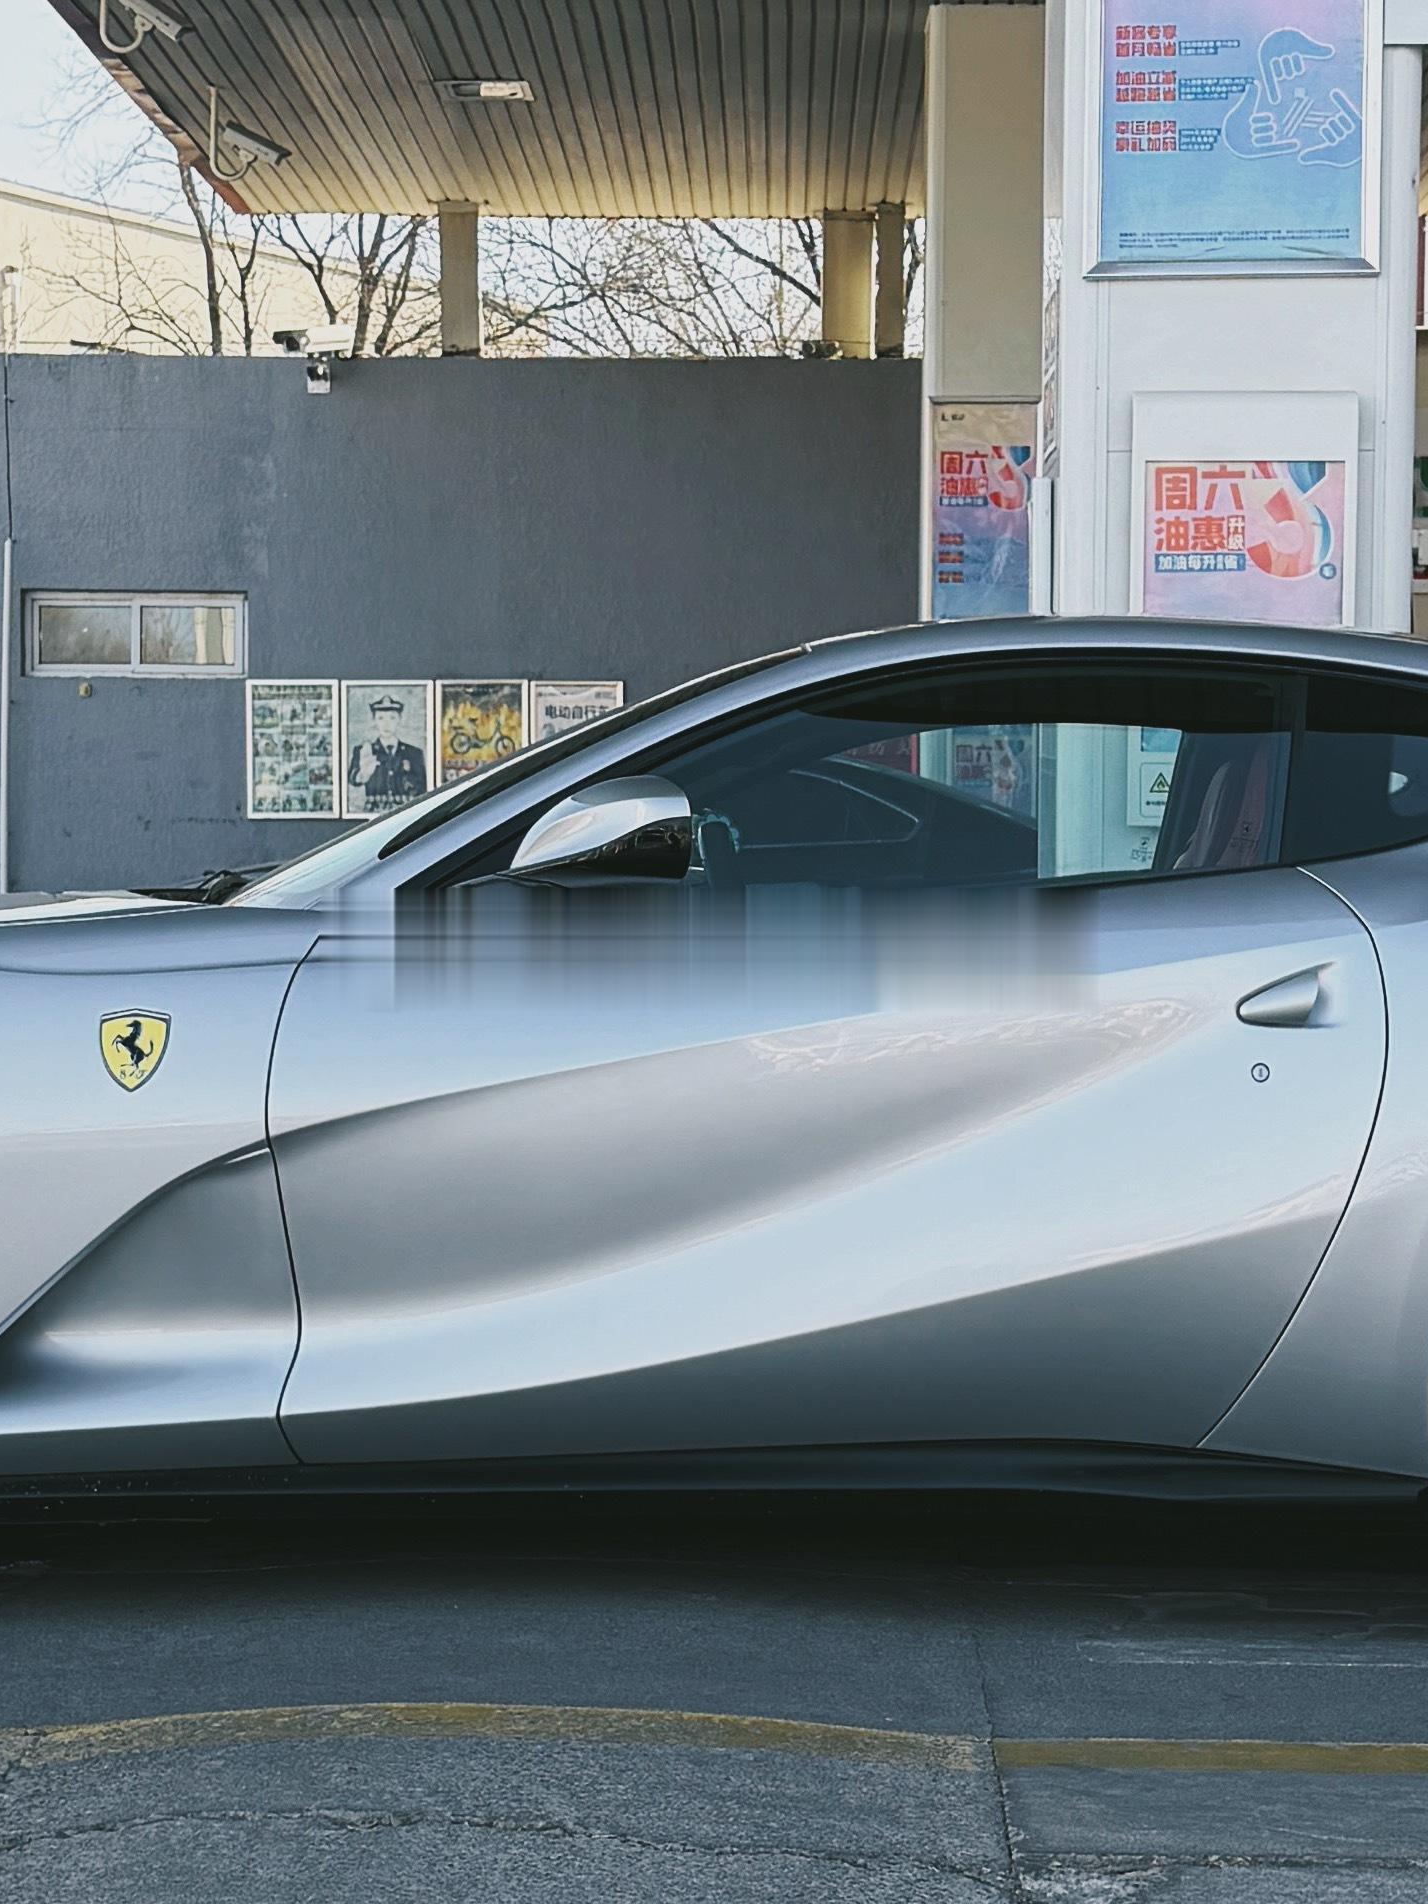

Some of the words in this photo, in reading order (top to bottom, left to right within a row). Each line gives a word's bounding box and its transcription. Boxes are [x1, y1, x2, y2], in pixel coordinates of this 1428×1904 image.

[940, 450, 988, 476] 周六
[1155, 465, 1246, 511] 周六
[1154, 517, 1226, 551] 油惠
